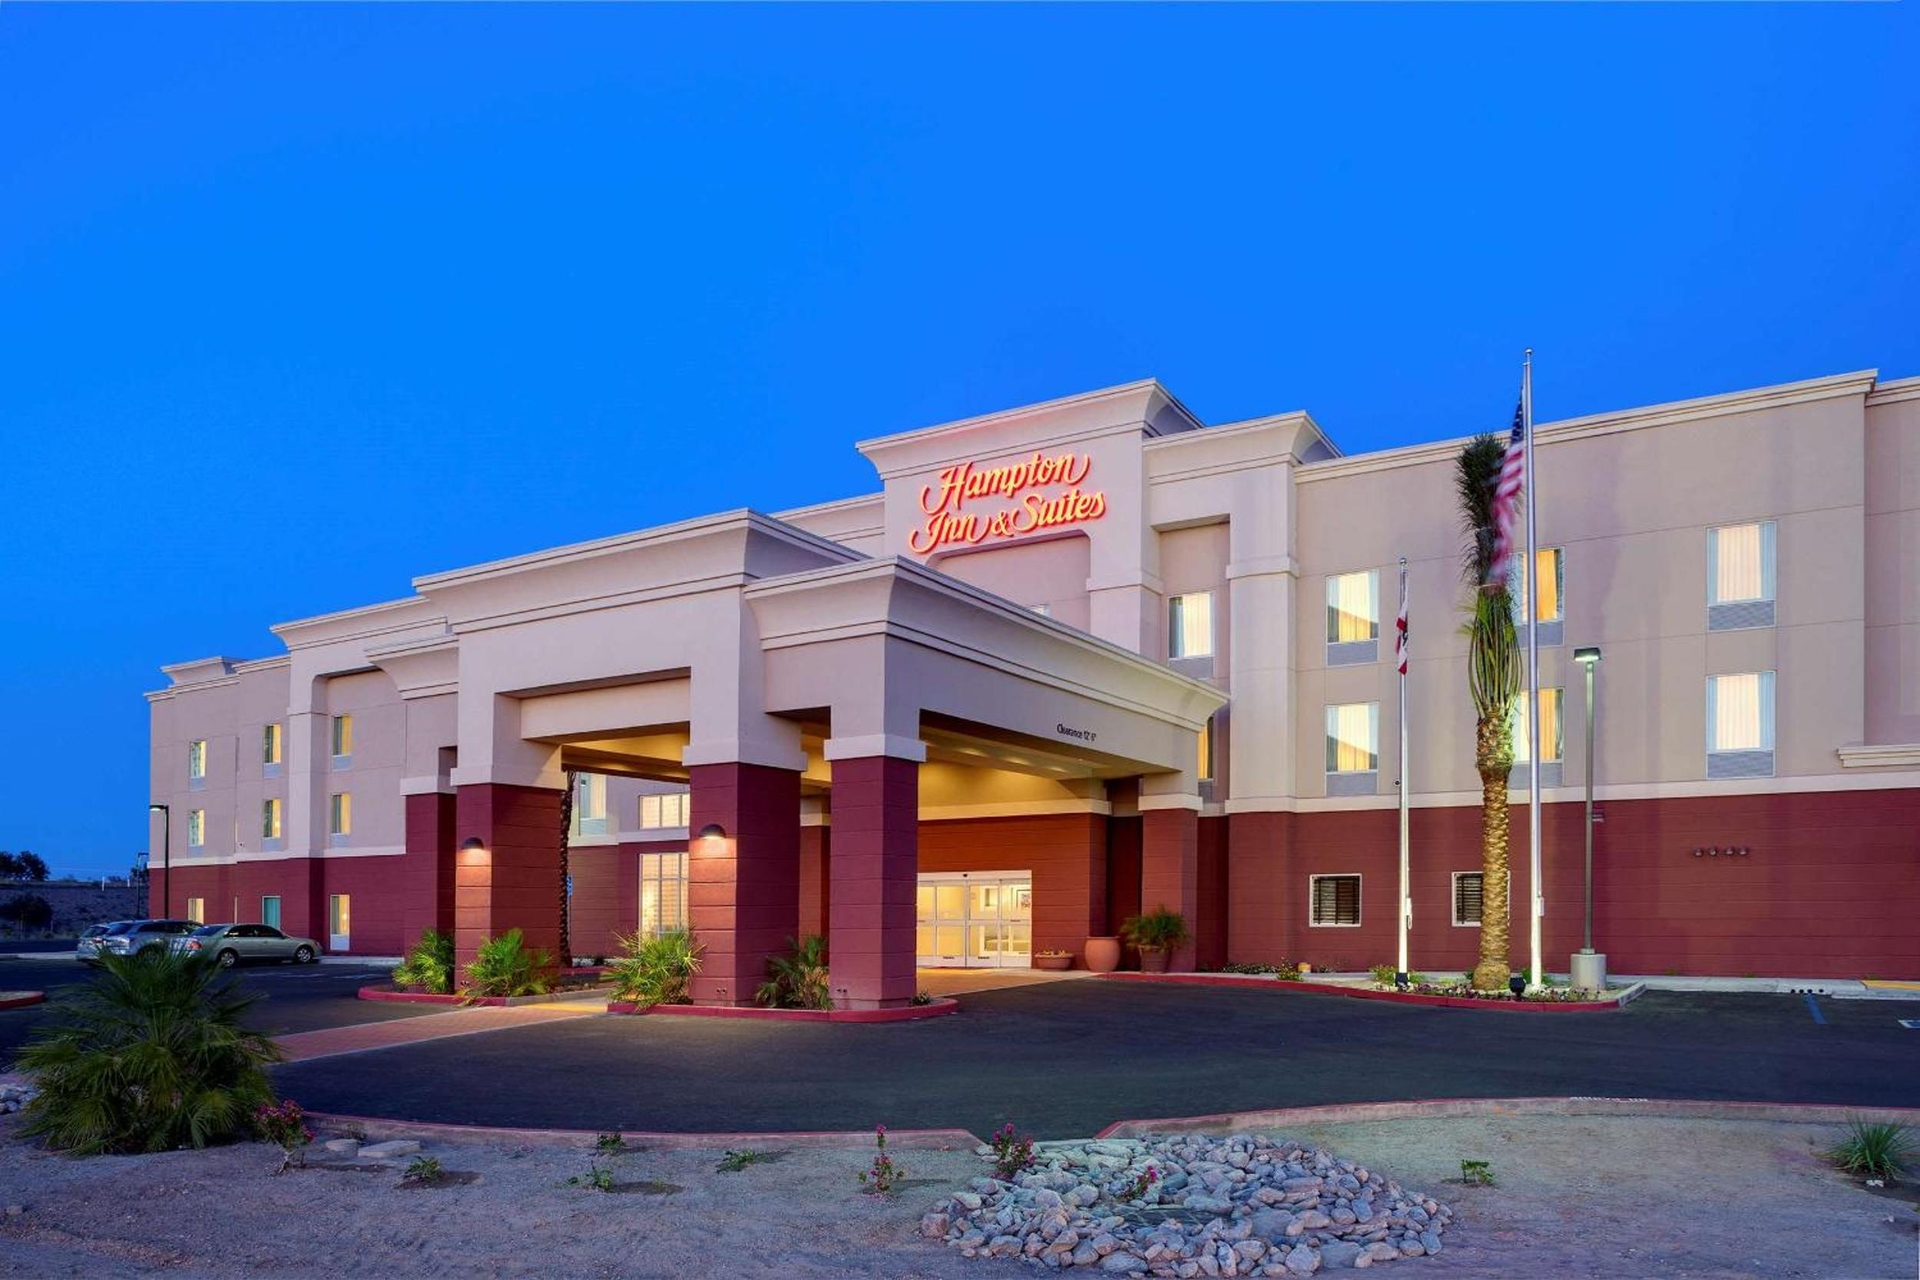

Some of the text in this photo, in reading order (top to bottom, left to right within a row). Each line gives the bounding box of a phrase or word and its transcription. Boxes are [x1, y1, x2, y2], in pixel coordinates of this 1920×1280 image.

[920, 453, 1090, 515] Hampton
[909, 489, 1106, 554] Inn & Suites
